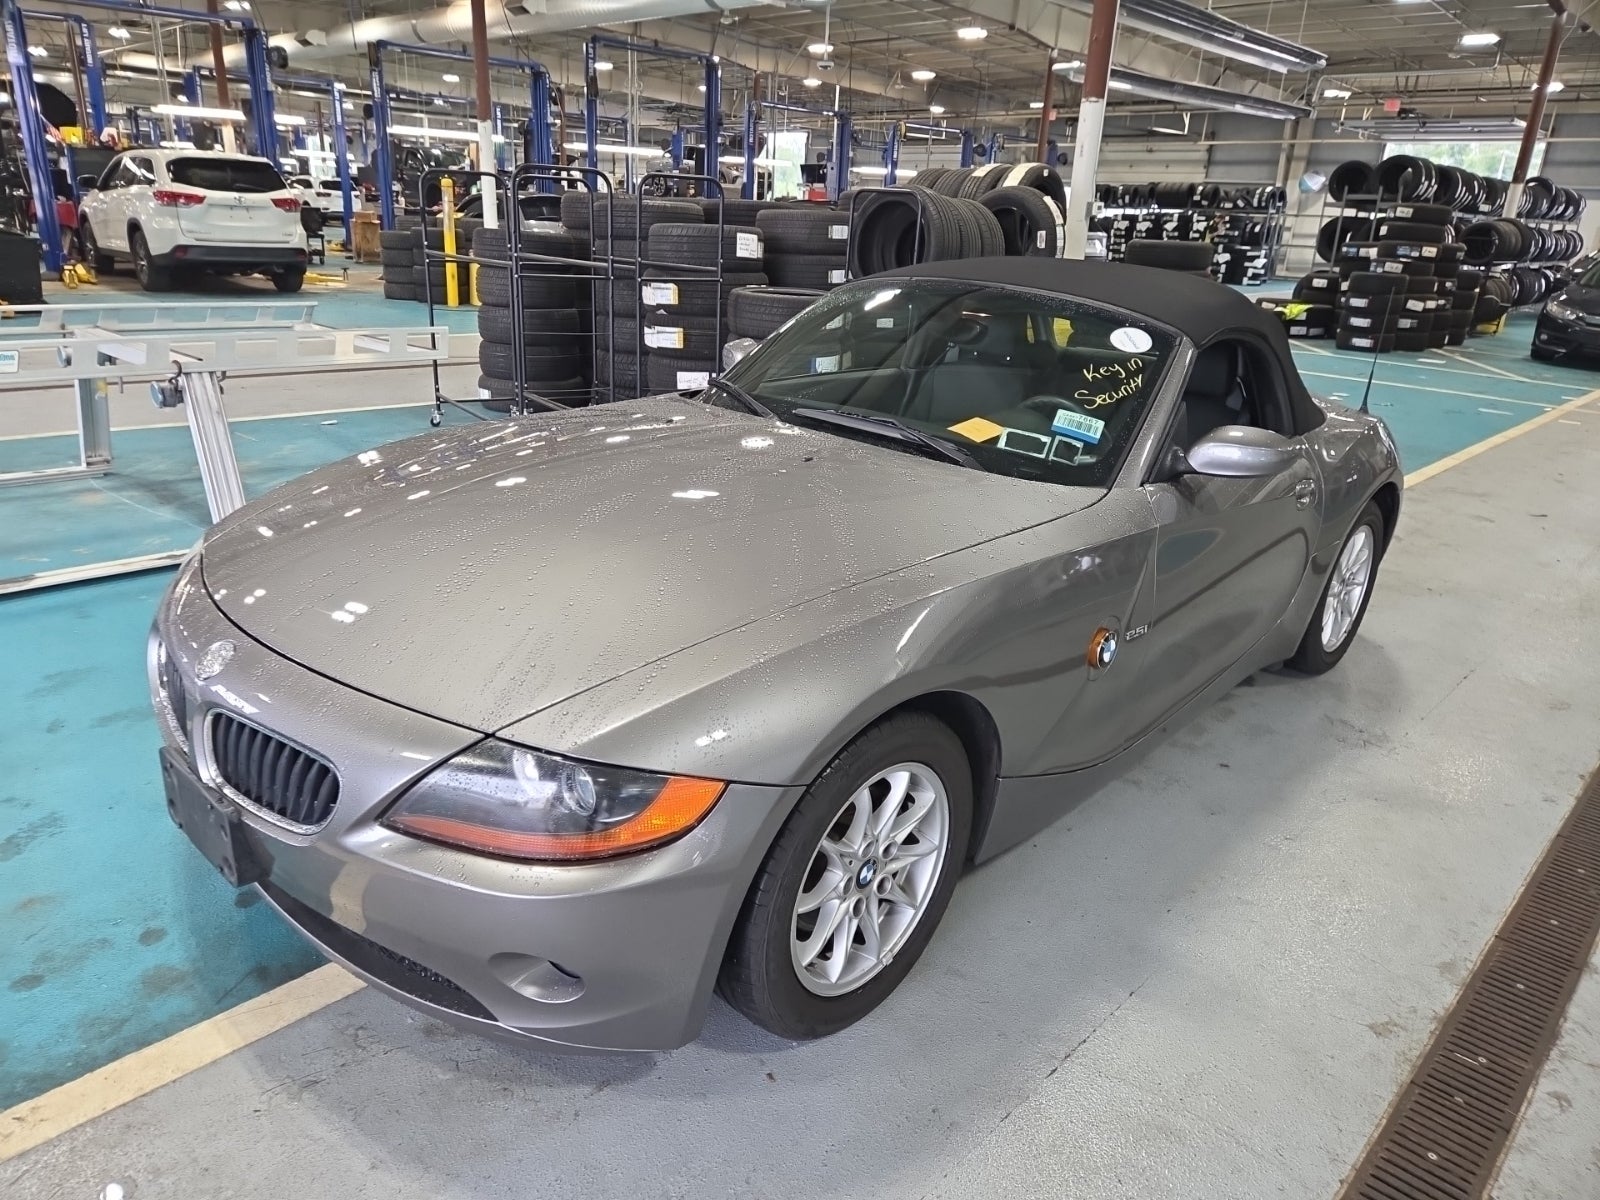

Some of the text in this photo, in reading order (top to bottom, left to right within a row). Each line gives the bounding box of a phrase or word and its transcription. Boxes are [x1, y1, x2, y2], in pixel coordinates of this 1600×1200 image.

[81, 22, 93, 64] ROTARY LIFT
[1082, 363, 1126, 382] Key
[1074, 374, 1143, 409] Security
